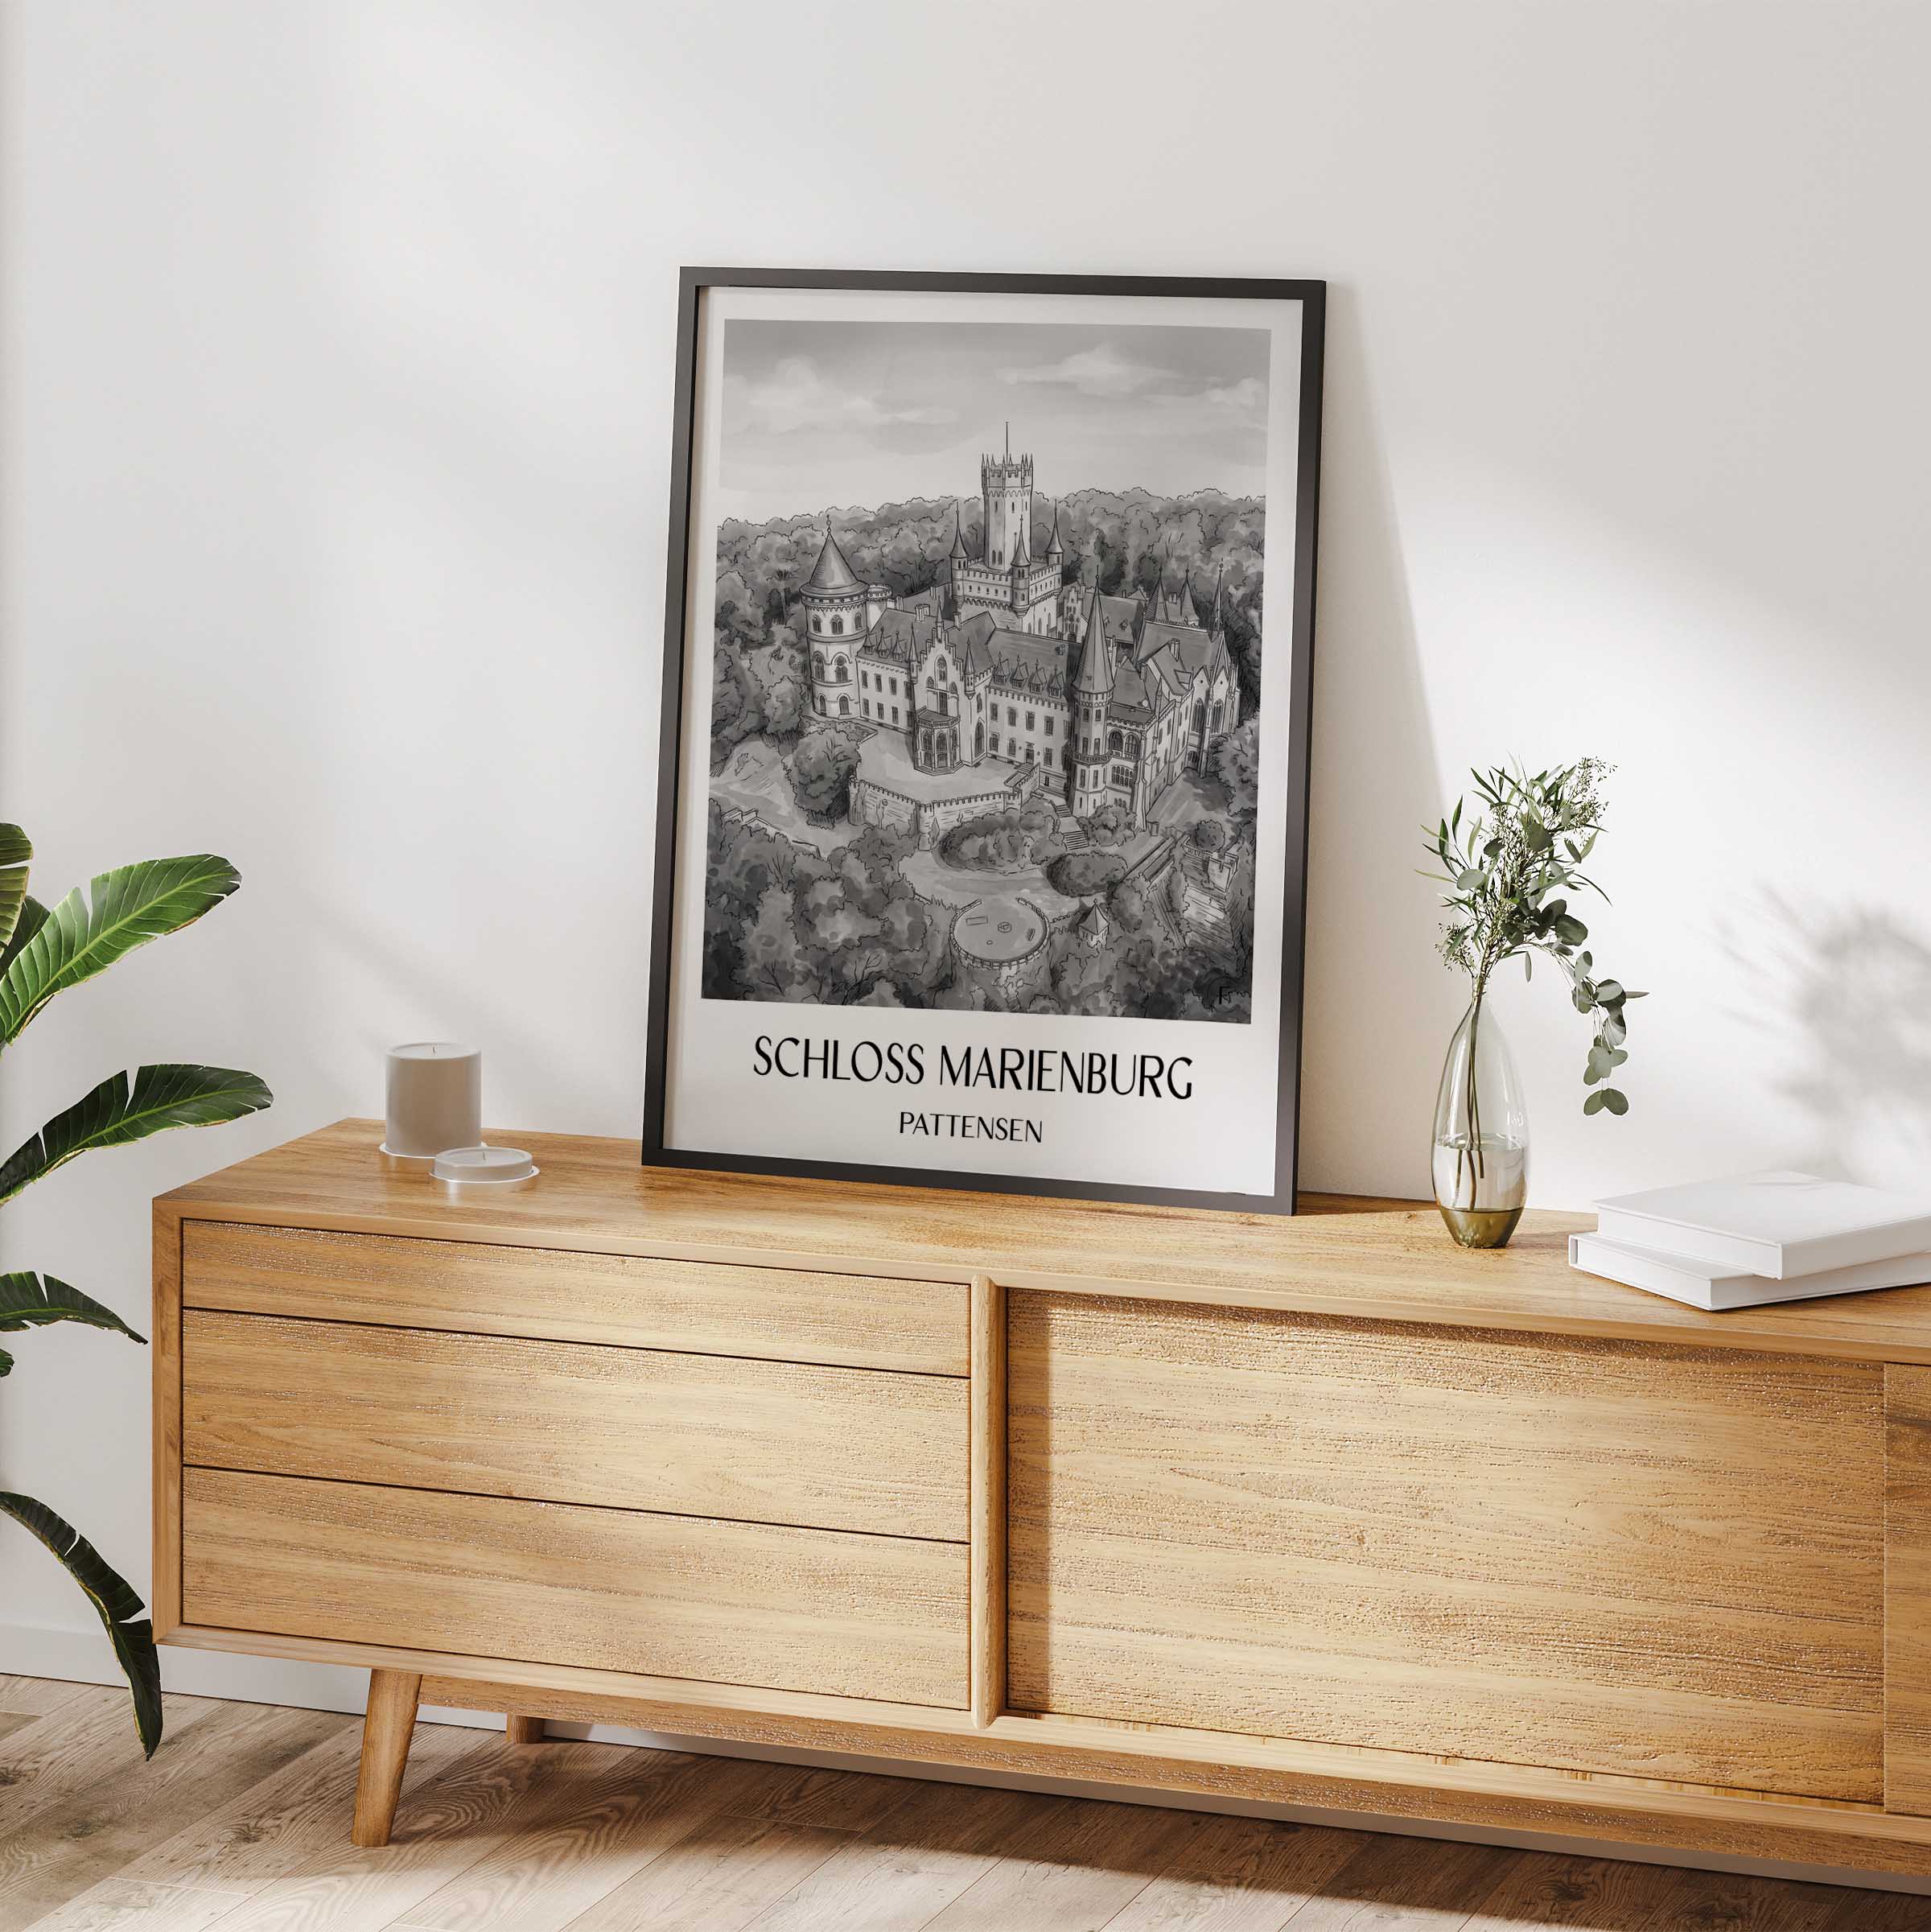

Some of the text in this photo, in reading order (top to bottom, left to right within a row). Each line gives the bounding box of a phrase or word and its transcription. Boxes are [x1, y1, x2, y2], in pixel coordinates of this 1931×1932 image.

[753, 1035, 1193, 1100] SCHLOSS MARIENBURG
[899, 1111, 1043, 1143] PATTENSEN
